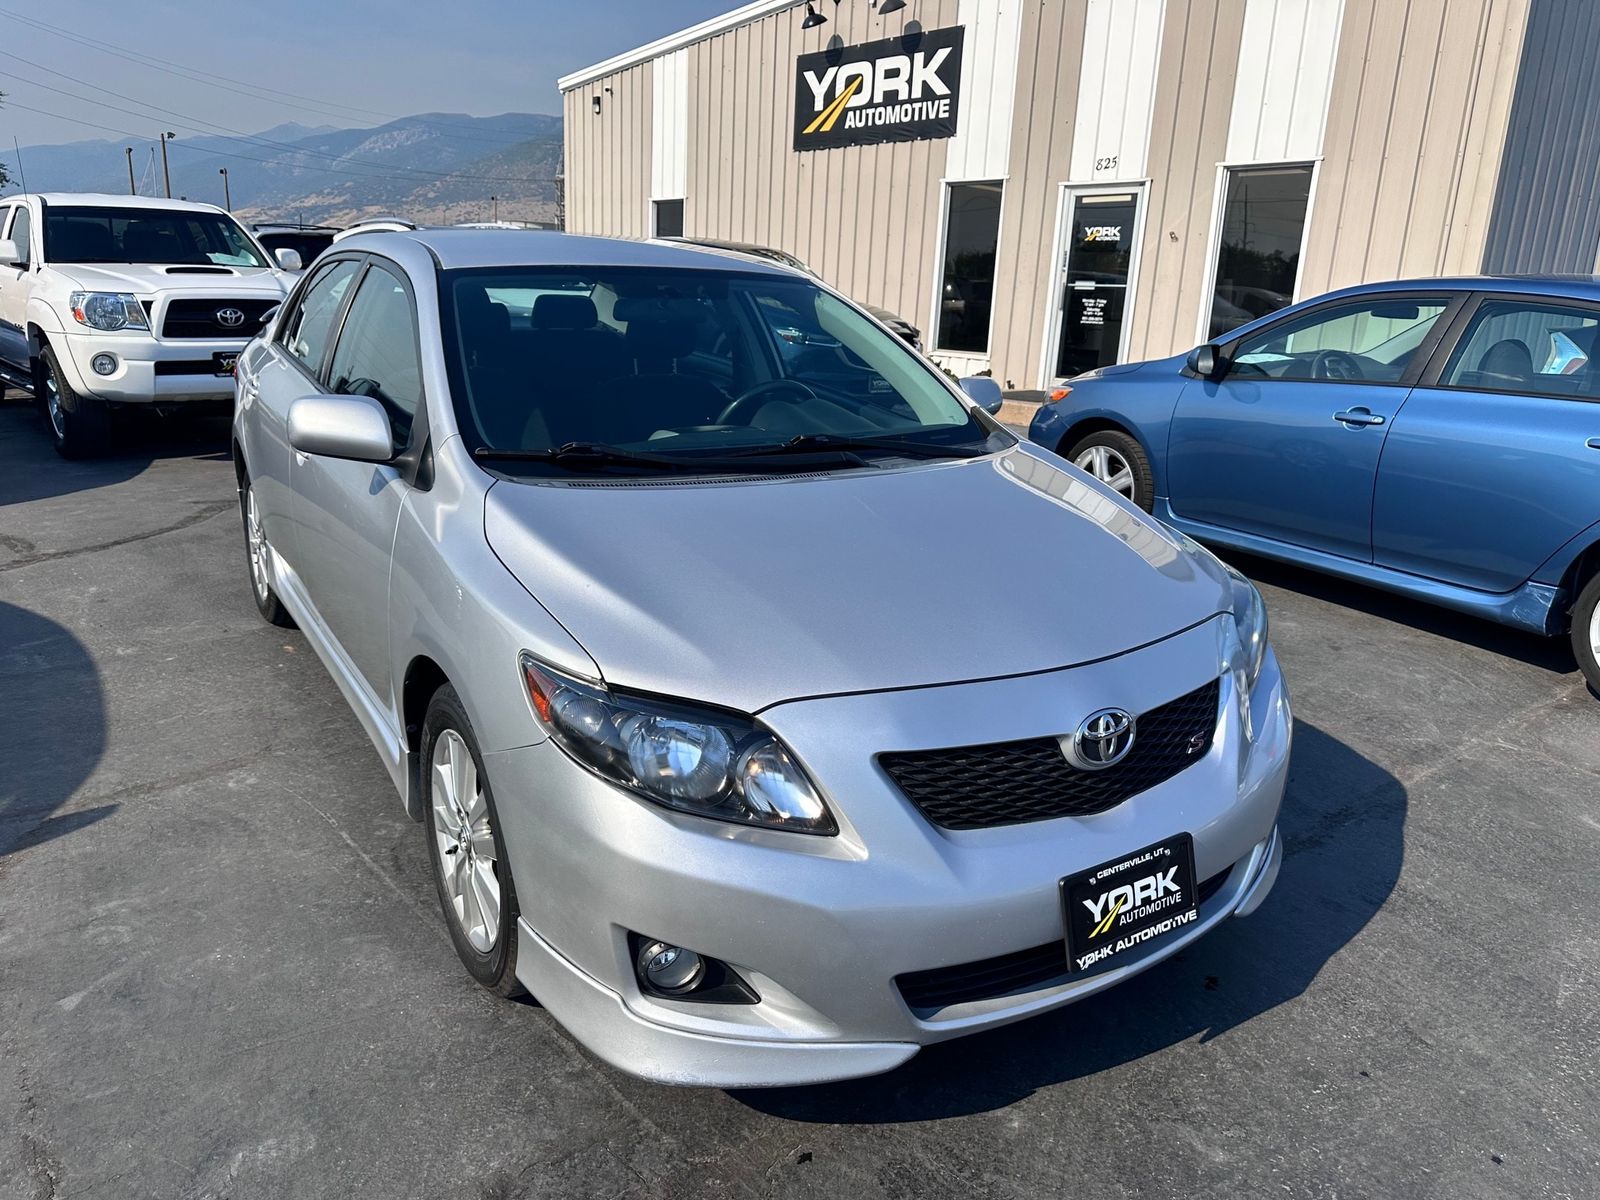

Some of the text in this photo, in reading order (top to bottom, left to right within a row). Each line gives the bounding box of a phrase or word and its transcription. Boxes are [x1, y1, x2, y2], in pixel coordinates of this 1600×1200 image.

[803, 47, 953, 112] YORK
[844, 98, 950, 129] AUTOMOTIVE
[1096, 155, 1118, 171] 825
[1084, 226, 1121, 236] YORK
[1096, 847, 1165, 879] CENTERVILLE, UT
[1082, 865, 1181, 923] YORK
[1119, 891, 1182, 927] AUTOMOTIVE
[1115, 909, 1198, 953] AUTOMOTIVE
